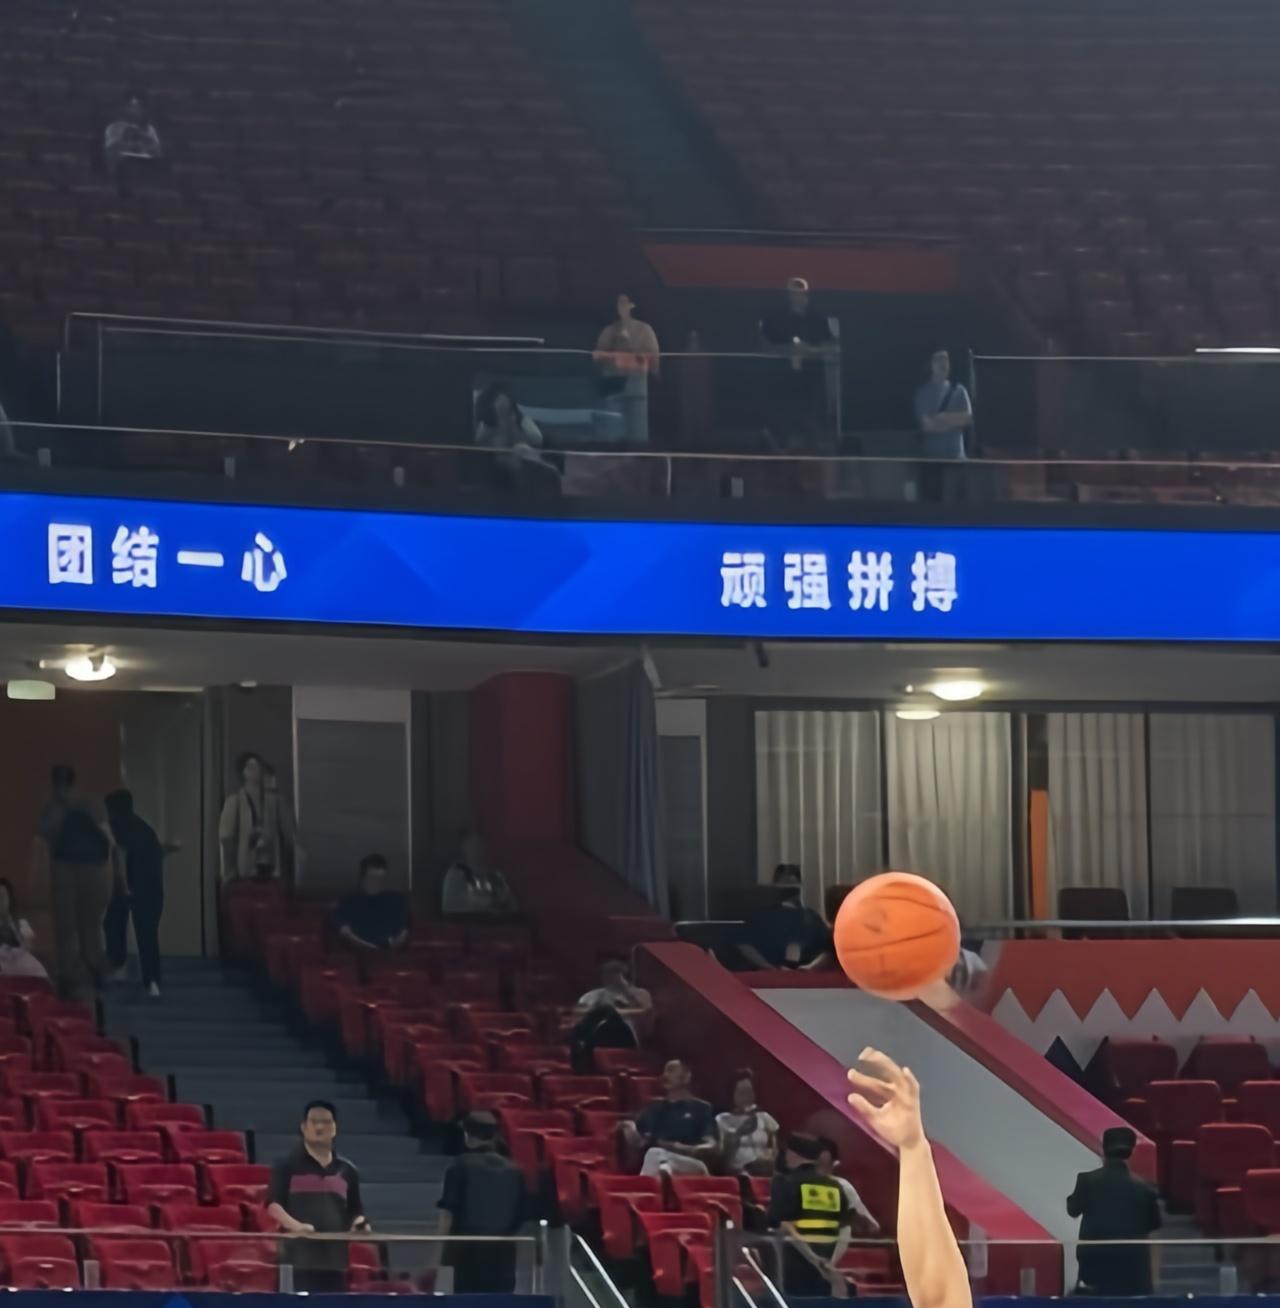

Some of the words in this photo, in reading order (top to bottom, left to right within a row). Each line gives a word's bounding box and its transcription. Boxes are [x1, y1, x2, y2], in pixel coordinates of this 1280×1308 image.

[48, 523, 288, 592] 团结一心
[720, 551, 958, 612] 顽强拼搏
